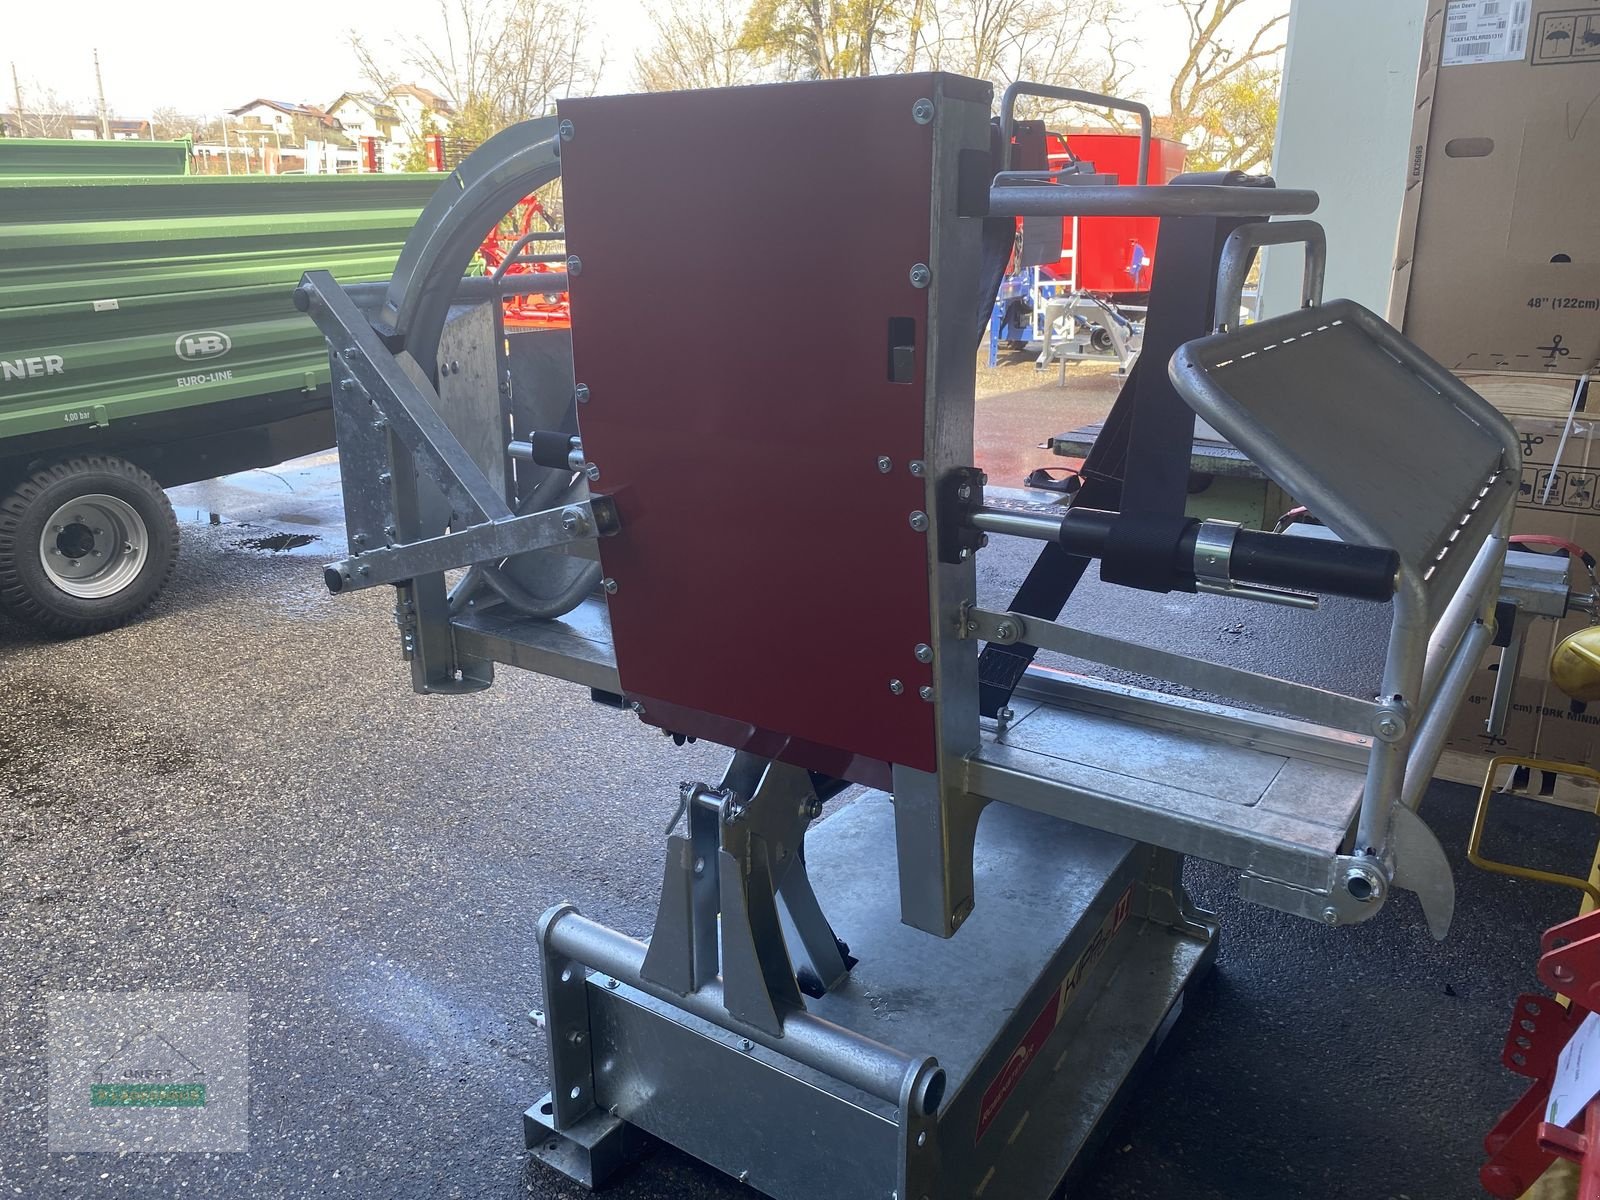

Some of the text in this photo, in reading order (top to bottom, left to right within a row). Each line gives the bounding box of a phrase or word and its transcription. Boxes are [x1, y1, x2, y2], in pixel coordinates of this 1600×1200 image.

[1527, 297, 1600, 311] 48" (122cm)
[184, 335, 224, 357] HB
[0, 355, 64, 381] NER
[177, 370, 233, 387] EURO-LINE
[79, 411, 90, 420] bar
[1536, 705, 1565, 719] FORK
